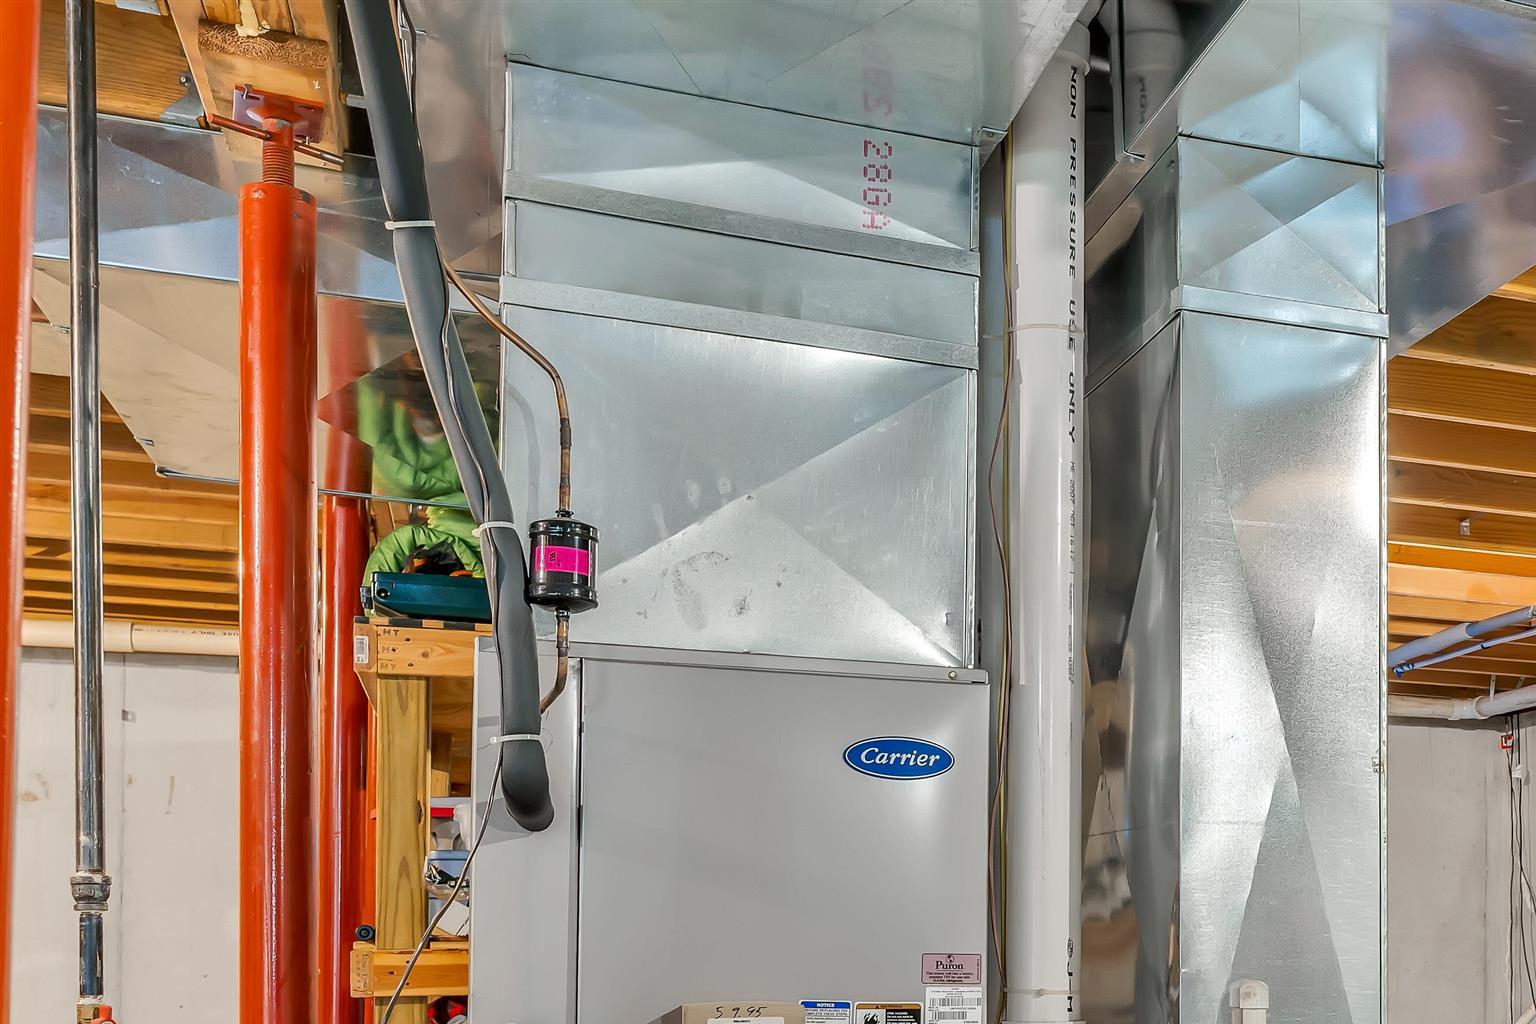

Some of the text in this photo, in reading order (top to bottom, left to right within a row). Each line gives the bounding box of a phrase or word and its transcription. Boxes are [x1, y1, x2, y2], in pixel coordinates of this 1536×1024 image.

[1070, 65, 1078, 120] NON
[864, 139, 892, 229] 28GA
[1068, 137, 1077, 279] PRESSURE
[1068, 371, 1076, 443] ONLY
[860, 747, 940, 766] Carrier
[936, 960, 964, 970] Puron
